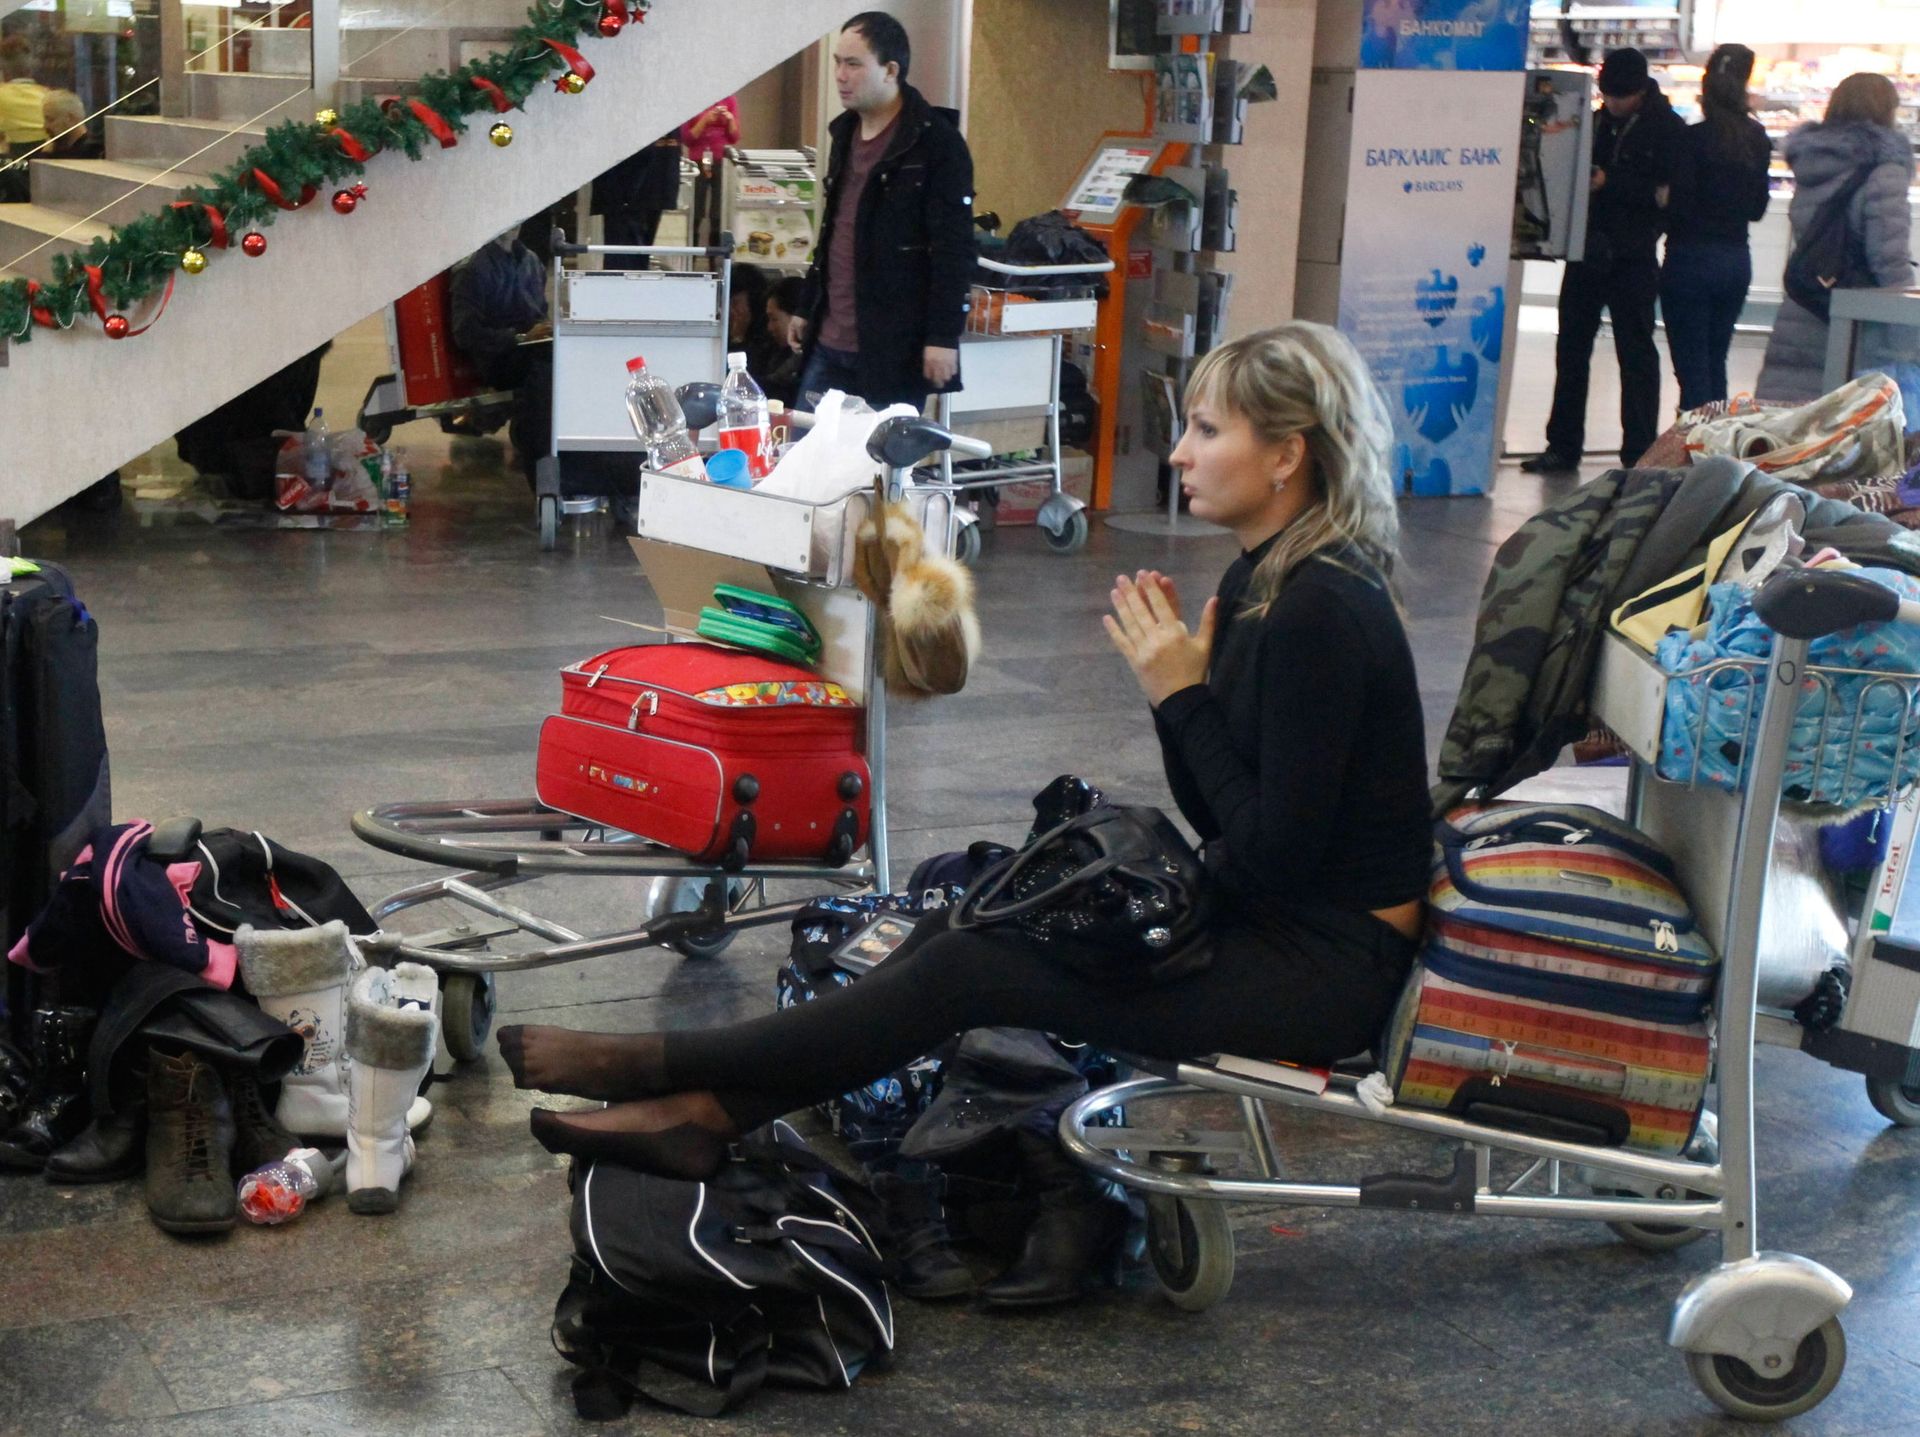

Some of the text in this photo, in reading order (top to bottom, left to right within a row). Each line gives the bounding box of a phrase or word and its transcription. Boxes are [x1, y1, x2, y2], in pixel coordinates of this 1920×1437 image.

[1400, 19, 1486, 37] БАНКОМАТ
[1460, 147, 1502, 165] БАНК
[743, 184, 777, 194] Tefal
[1415, 180, 1464, 192] BARCLAYS
[1881, 846, 1901, 895] Tefal
